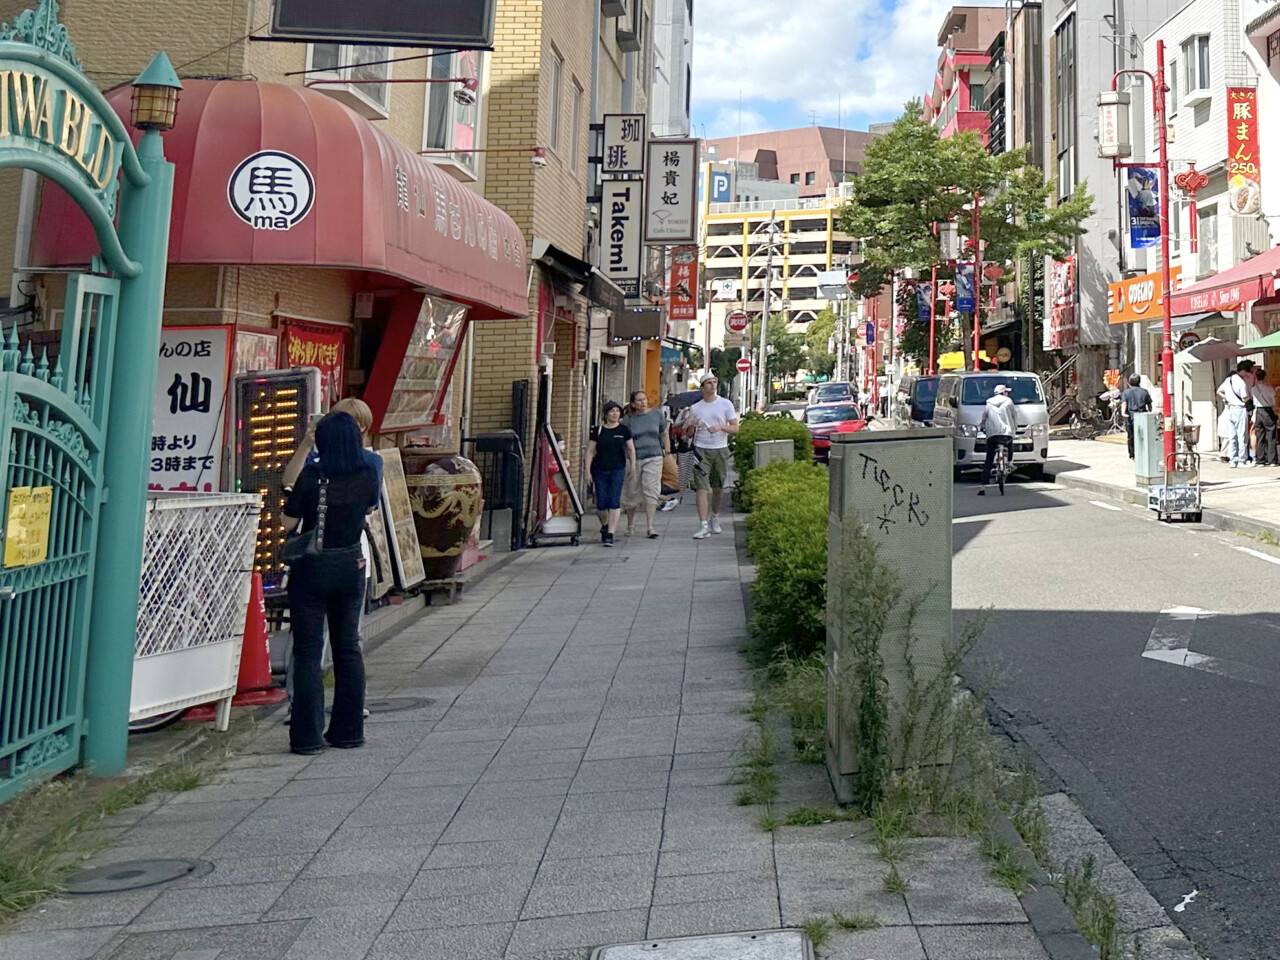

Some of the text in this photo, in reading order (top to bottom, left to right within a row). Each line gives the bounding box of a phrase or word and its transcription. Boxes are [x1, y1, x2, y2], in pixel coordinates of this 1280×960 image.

[60, 89, 115, 189] BLD
[1232, 102, 1253, 161] 豚まん
[244, 166, 298, 216] 馬
[661, 150, 680, 206] 楊貴妃
[714, 176, 728, 198] P
[253, 215, 289, 229] ma
[610, 187, 630, 273] Takemi
[167, 372, 212, 415] 仙
